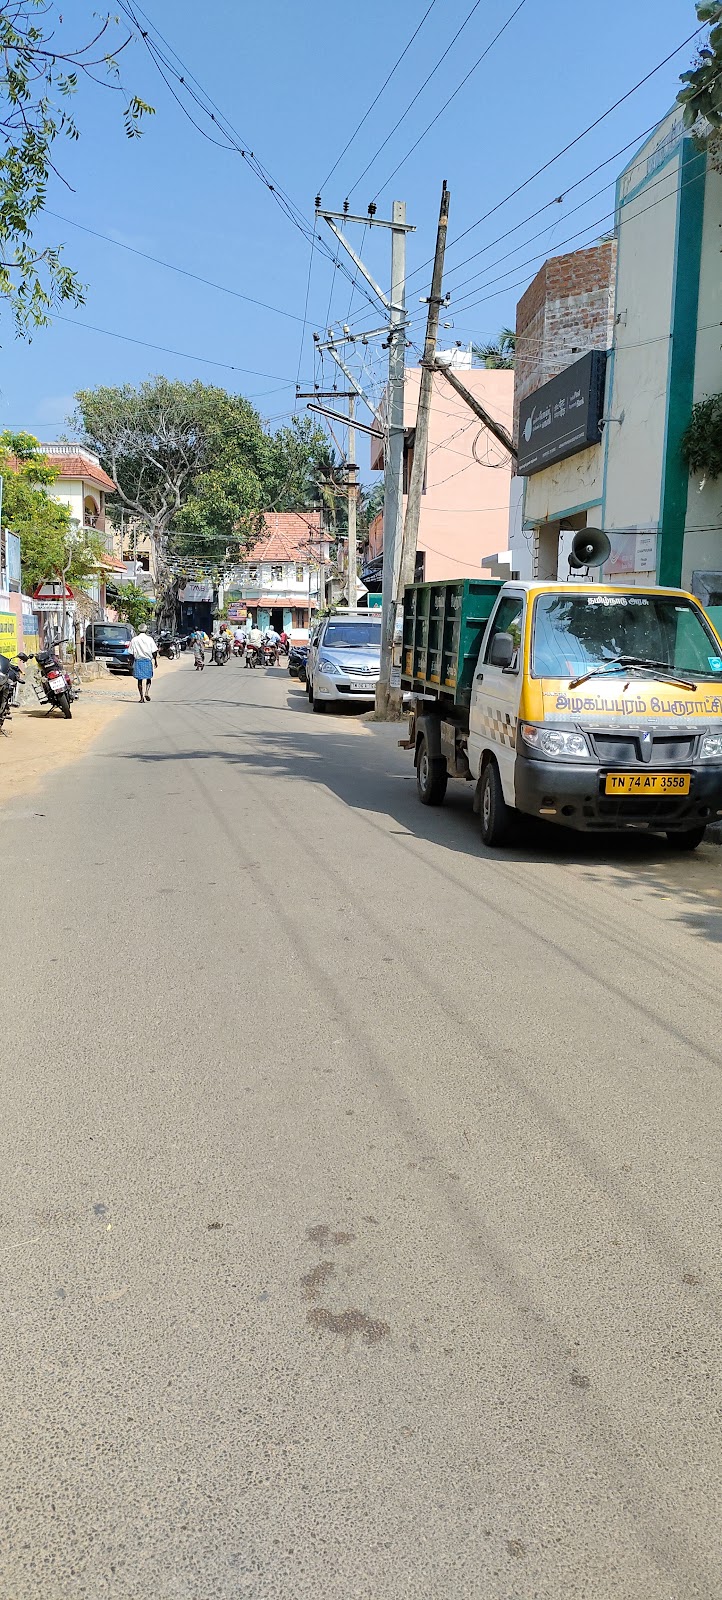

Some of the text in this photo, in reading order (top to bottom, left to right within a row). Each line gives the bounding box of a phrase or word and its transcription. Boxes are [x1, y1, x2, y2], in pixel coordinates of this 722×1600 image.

[189, 584, 206, 592] TMB
[555, 695, 647, 715] அழகப்பபுரம்
[611, 776, 685, 787] TN 74 AT 3558
